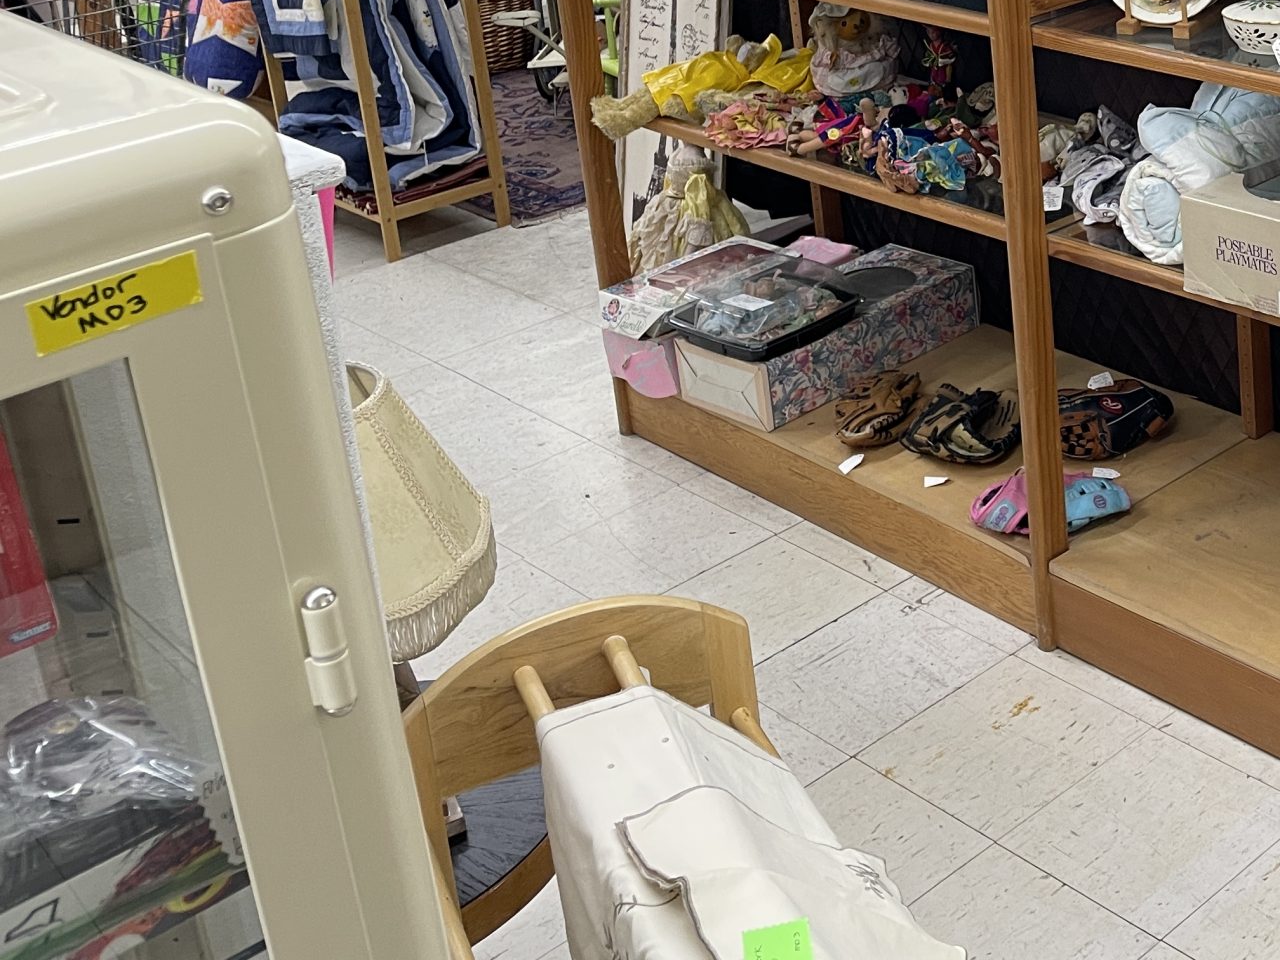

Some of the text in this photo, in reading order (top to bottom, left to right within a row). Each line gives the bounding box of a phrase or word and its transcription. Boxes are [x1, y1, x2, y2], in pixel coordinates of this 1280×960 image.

[1215, 248, 1278, 275] PLAYMATES
[1217, 236, 1274, 262] POSEABLE
[40, 273, 138, 321] Vendor
